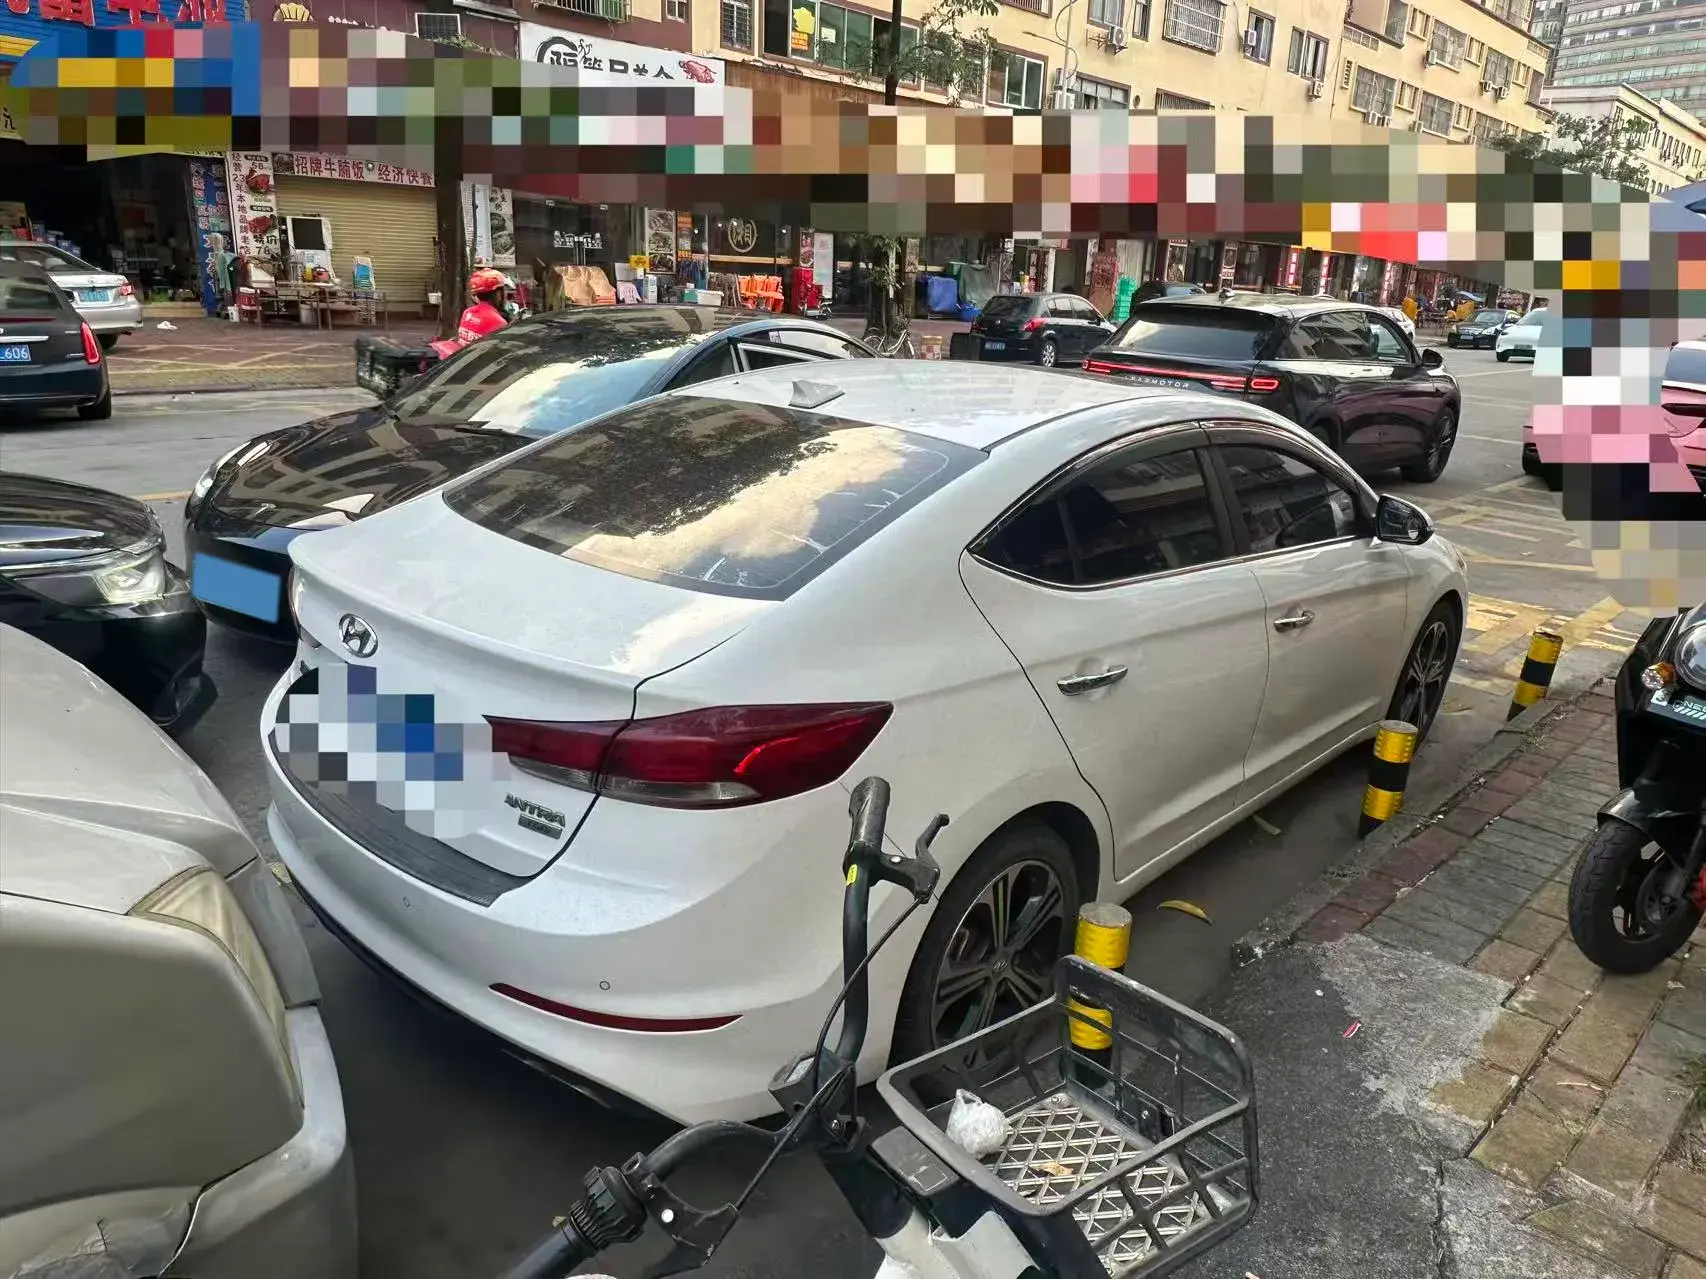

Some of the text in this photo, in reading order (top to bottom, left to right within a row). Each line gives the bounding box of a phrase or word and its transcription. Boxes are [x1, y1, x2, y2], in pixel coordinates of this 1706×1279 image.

[295, 155, 365, 179] 招牌牛腩饭
